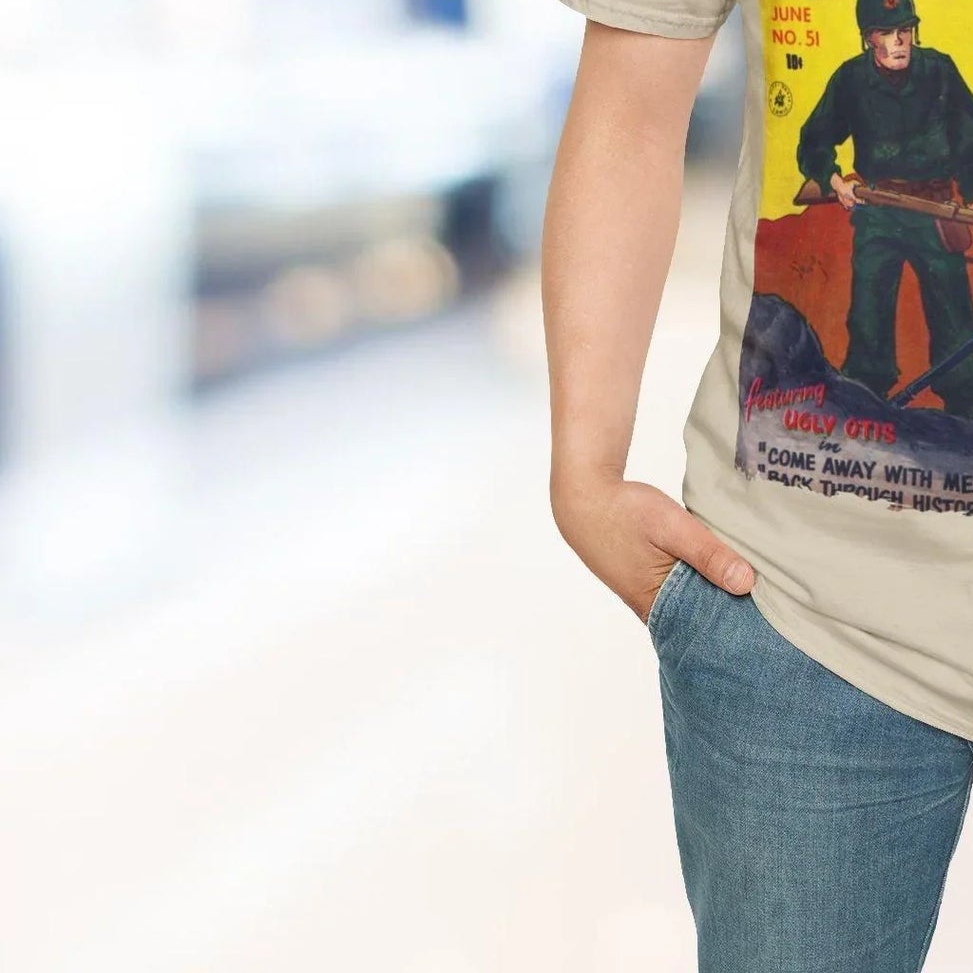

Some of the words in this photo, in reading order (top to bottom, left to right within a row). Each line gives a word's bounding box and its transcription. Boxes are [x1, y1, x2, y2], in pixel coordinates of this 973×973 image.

[771, 6, 811, 23] JUNE
[745, 377, 826, 423] featuring
[783, 409, 837, 435] UGLY
[843, 417, 896, 444] OTIS
[818, 436, 842, 454] in
[821, 457, 877, 481] AWAY
[884, 464, 933, 489] WITH
